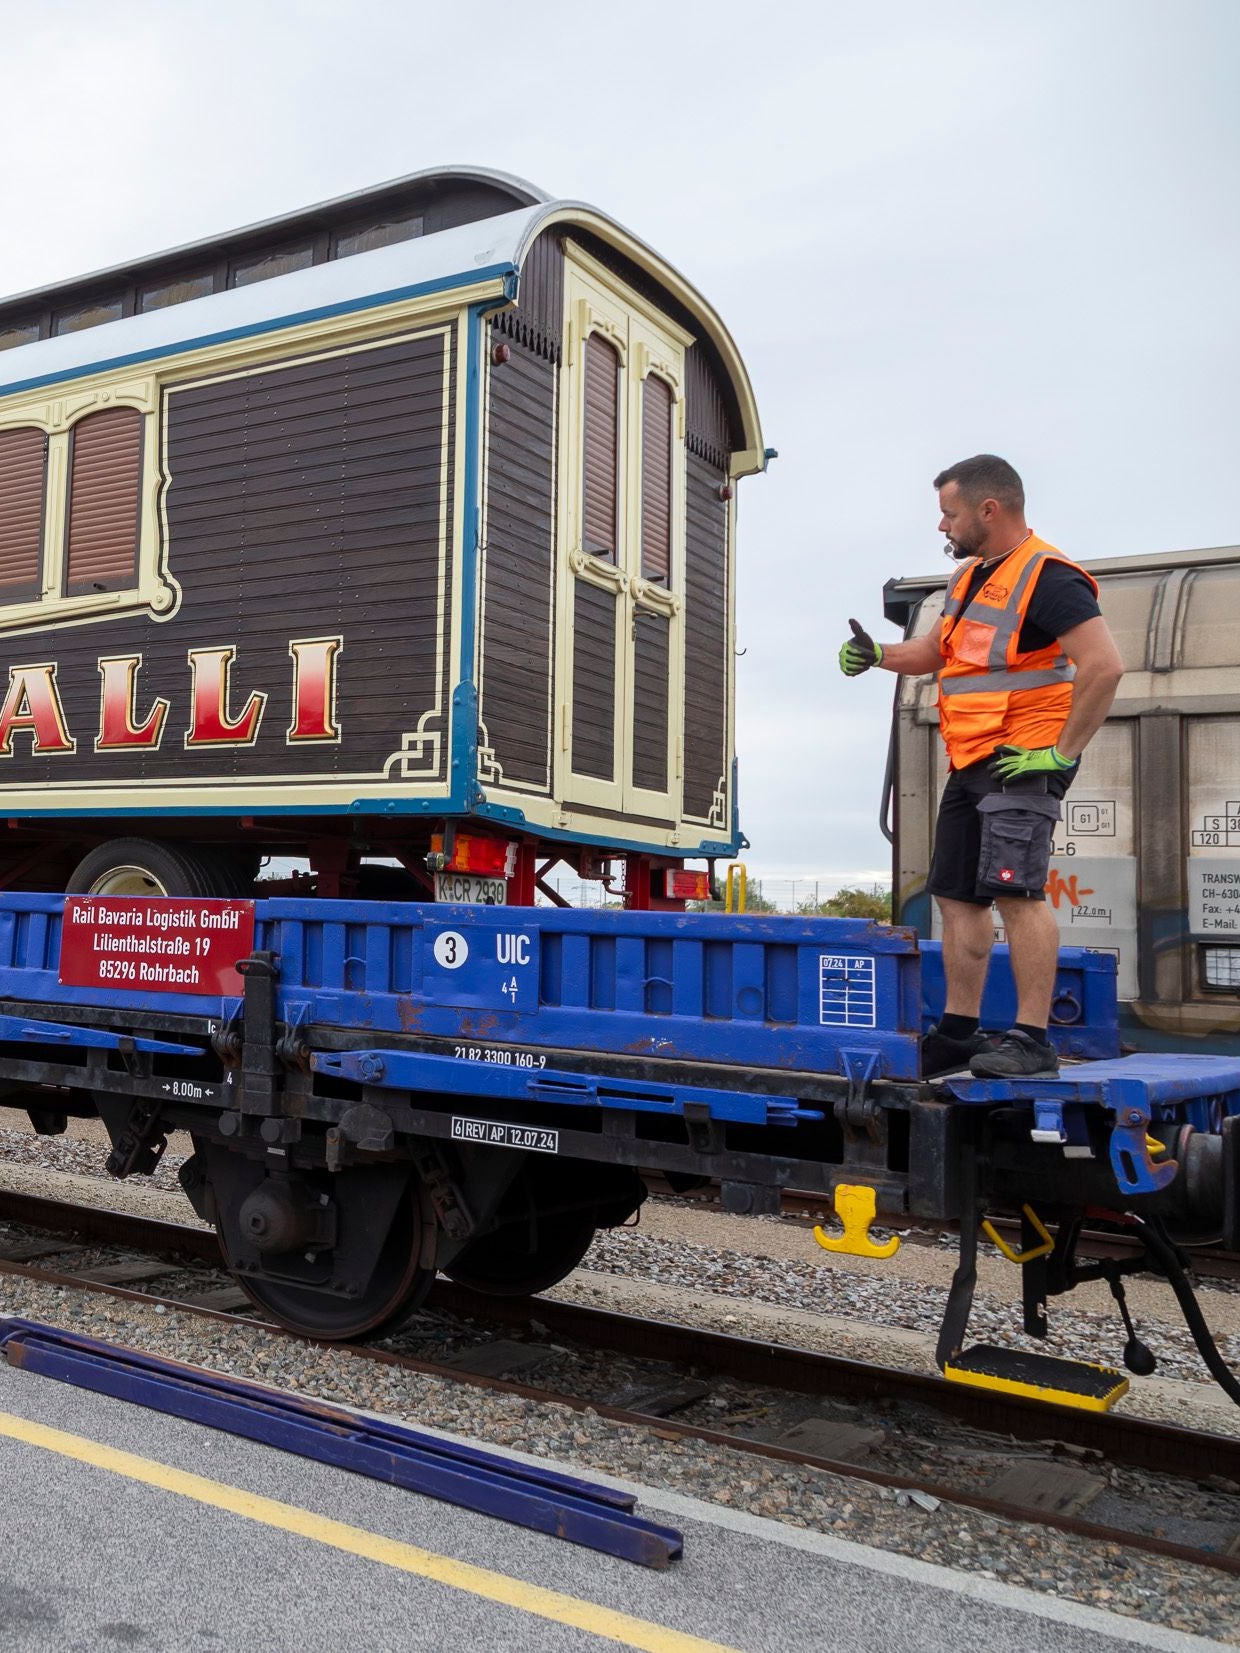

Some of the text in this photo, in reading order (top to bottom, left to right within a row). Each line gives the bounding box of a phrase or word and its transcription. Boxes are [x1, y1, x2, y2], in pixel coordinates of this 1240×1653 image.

[1080, 814, 1091, 824] G1
[1212, 819, 1220, 830] S
[1200, 833, 1219, 845] 120
[475, 880, 504, 905] 2930
[1202, 904, 1222, 914] Fax:
[72, 905, 239, 931] Rail Bavaria Logistik GmbH
[1202, 918, 1237, 930] E-Mail:
[93, 933, 211, 956] Lilienthalstraße 19
[445, 933, 531, 965] 3 UIC
[99, 959, 200, 984] 85296 Rohrbach
[823, 958, 865, 969] 07.24 AP
[501, 982, 508, 994] 4
[511, 976, 518, 988] A
[455, 1046, 547, 1069] 21 82 3300 160-9
[172, 1071, 233, 1098] 8.00m 4
[455, 1120, 555, 1149] 6 REV AP 12.07.24
